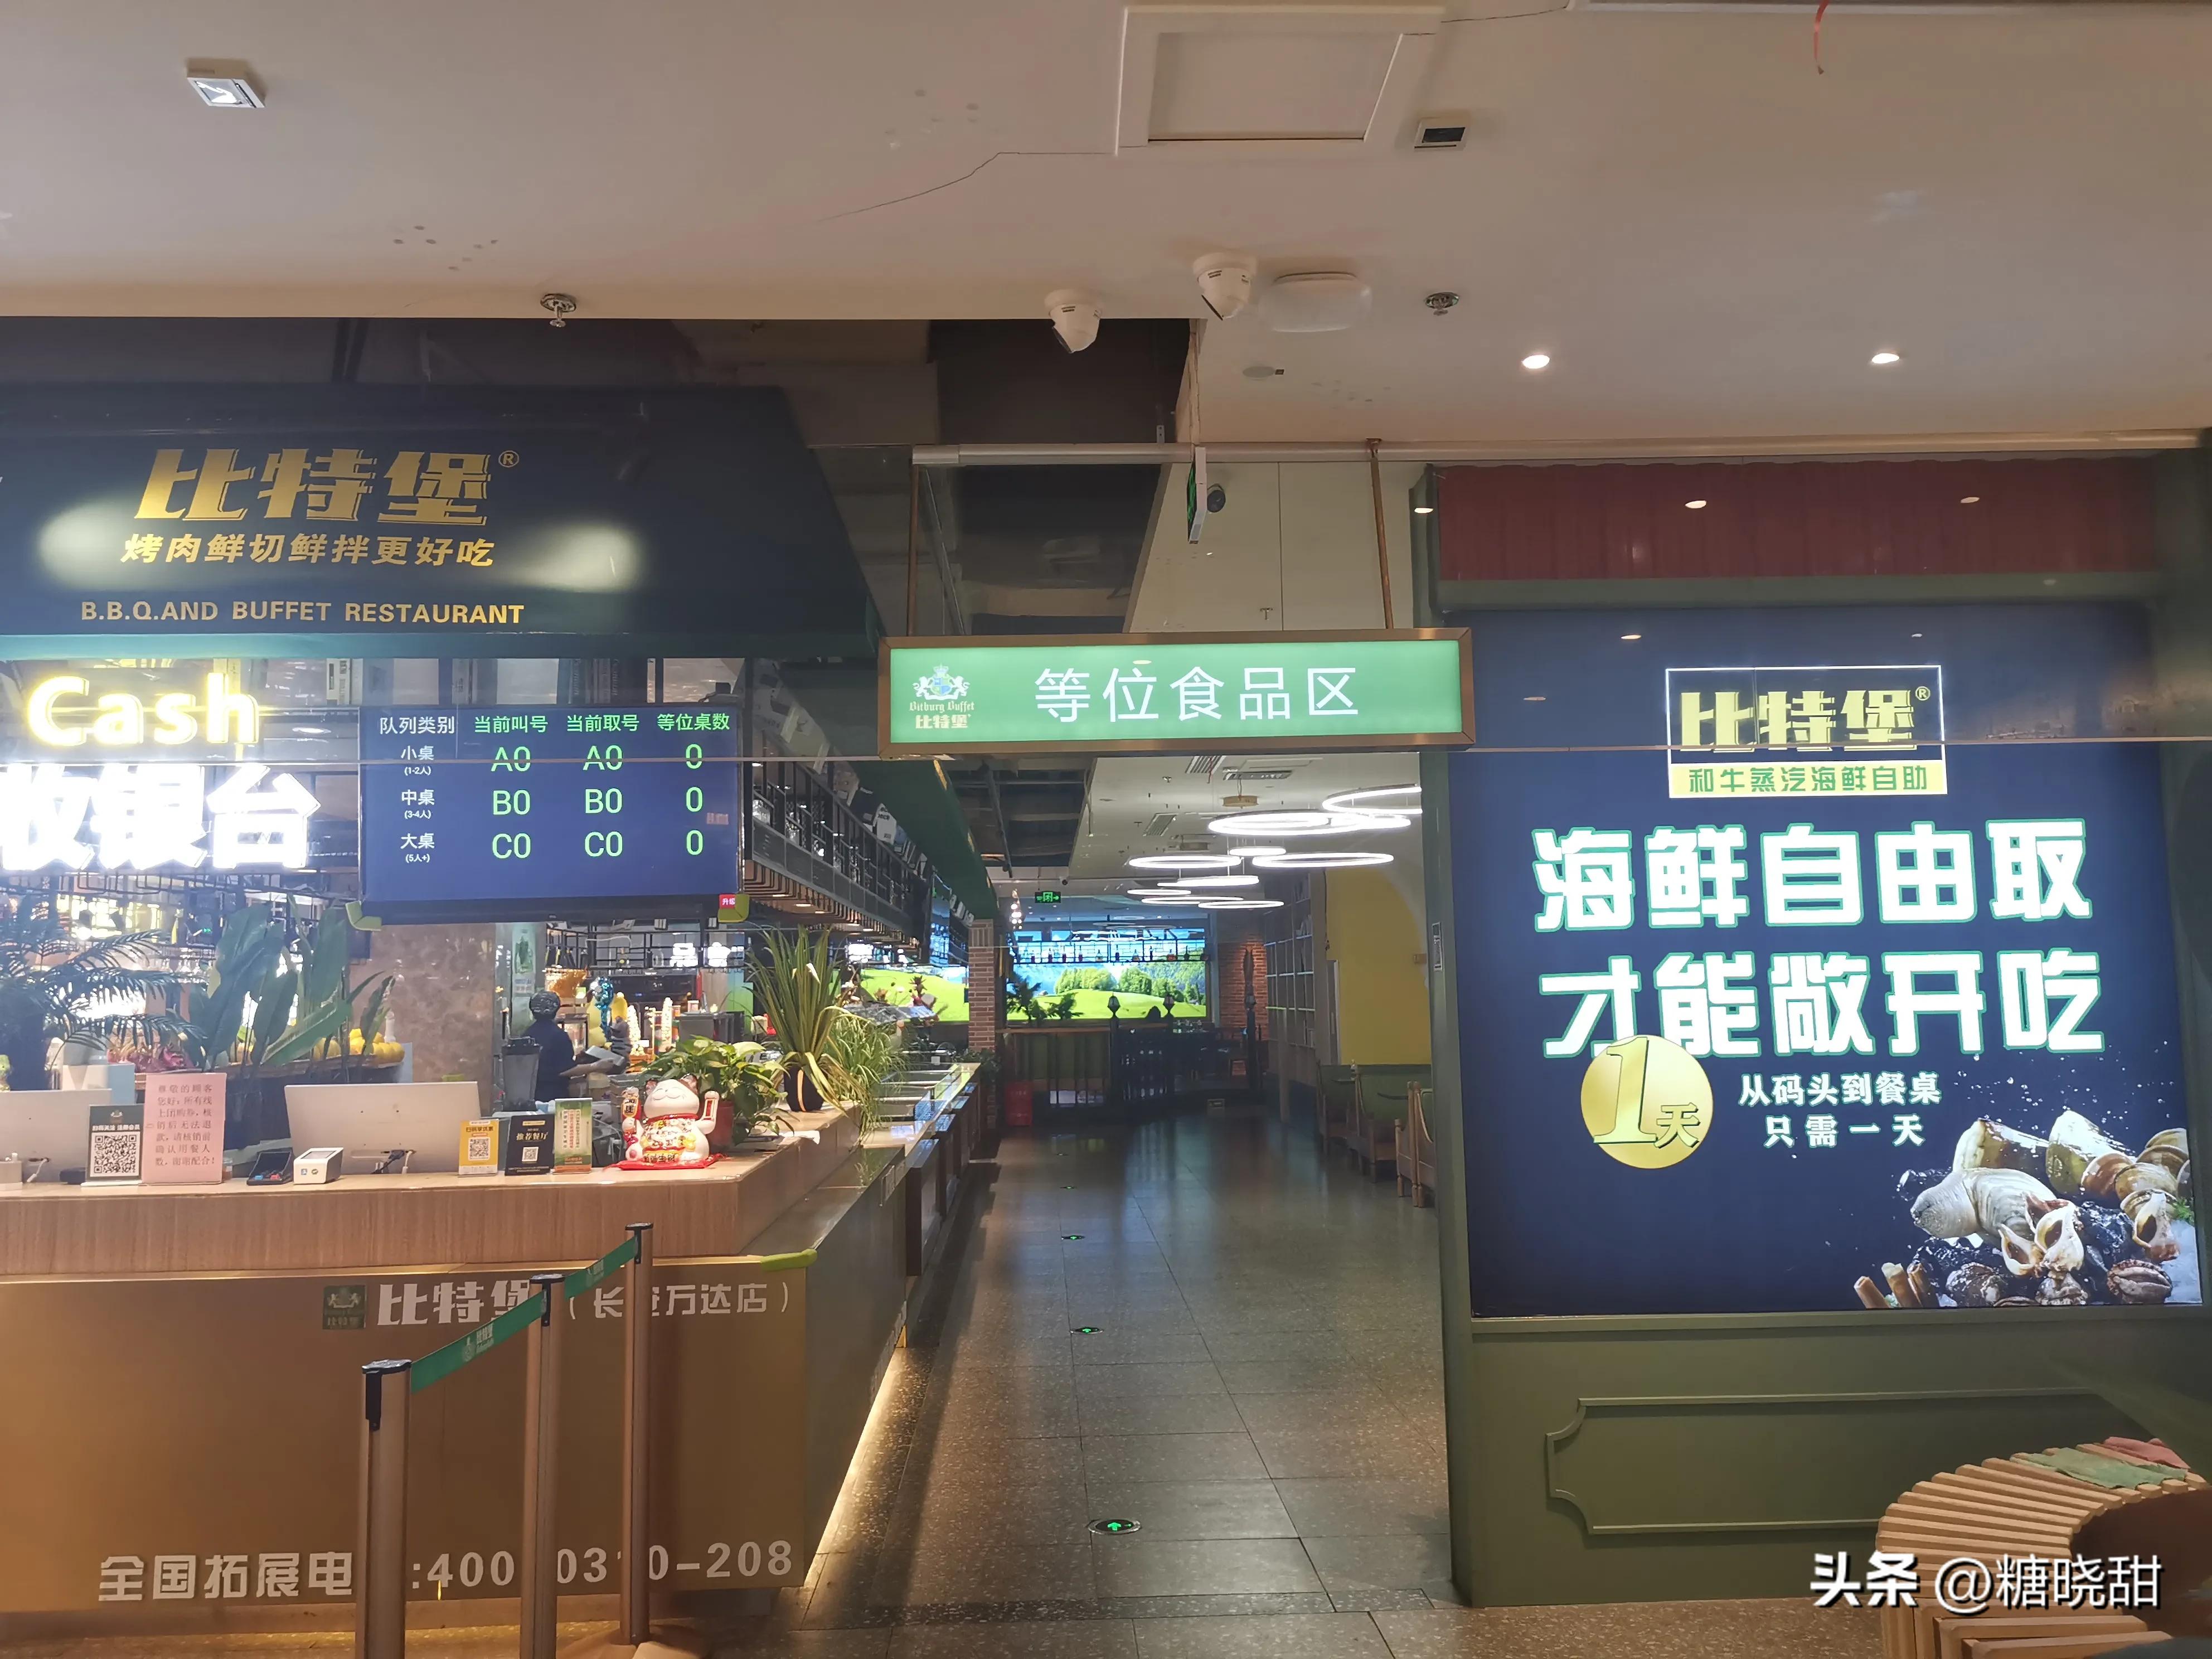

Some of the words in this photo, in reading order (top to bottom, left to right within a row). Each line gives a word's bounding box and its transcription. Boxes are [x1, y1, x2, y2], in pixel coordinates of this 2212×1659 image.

[134, 449, 492, 525] 比特堡
[120, 533, 496, 567] 烤肉鲜切鲜拌更好吃
[81, 601, 218, 621] B.B.Q.AND
[232, 602, 332, 622] BUFFET
[345, 603, 525, 625] RESTAURANT
[28, 672, 259, 746] Cash
[909, 701, 945, 713] Bitburg
[947, 701, 974, 712] Buffet
[1035, 666, 1359, 724] 等位食品区
[380, 716, 455, 734] 队列类别
[474, 715, 548, 733] 当前叫号
[567, 714, 639, 732] 当前取号
[657, 713, 730, 731] 等位桌数
[915, 714, 968, 729] 比特堡
[1680, 690, 1918, 753] 比特堡
[401, 745, 434, 760] 小桌
[491, 746, 531, 772] A0
[583, 745, 623, 770] A0
[686, 744, 702, 769] 0
[404, 766, 431, 775] (1-2人)
[1689, 765, 1928, 793] 和牛蒸汽海鲜自助
[401, 789, 435, 806] 中桌
[493, 790, 530, 815] B0
[585, 788, 623, 814] B0
[686, 787, 703, 812] 0
[404, 809, 431, 819] (3-4人)
[400, 832, 435, 849] 大桌
[492, 833, 531, 858] C0
[585, 831, 623, 857] C0
[686, 830, 704, 855] 0
[405, 853, 430, 863] (5人+)
[1531, 817, 2093, 932] 海鲜自由取
[1539, 948, 2105, 1059] 才能敞开吃
[1738, 1071, 1942, 1107] 从码头到餐桌
[1764, 1113, 1925, 1148] 只需一天
